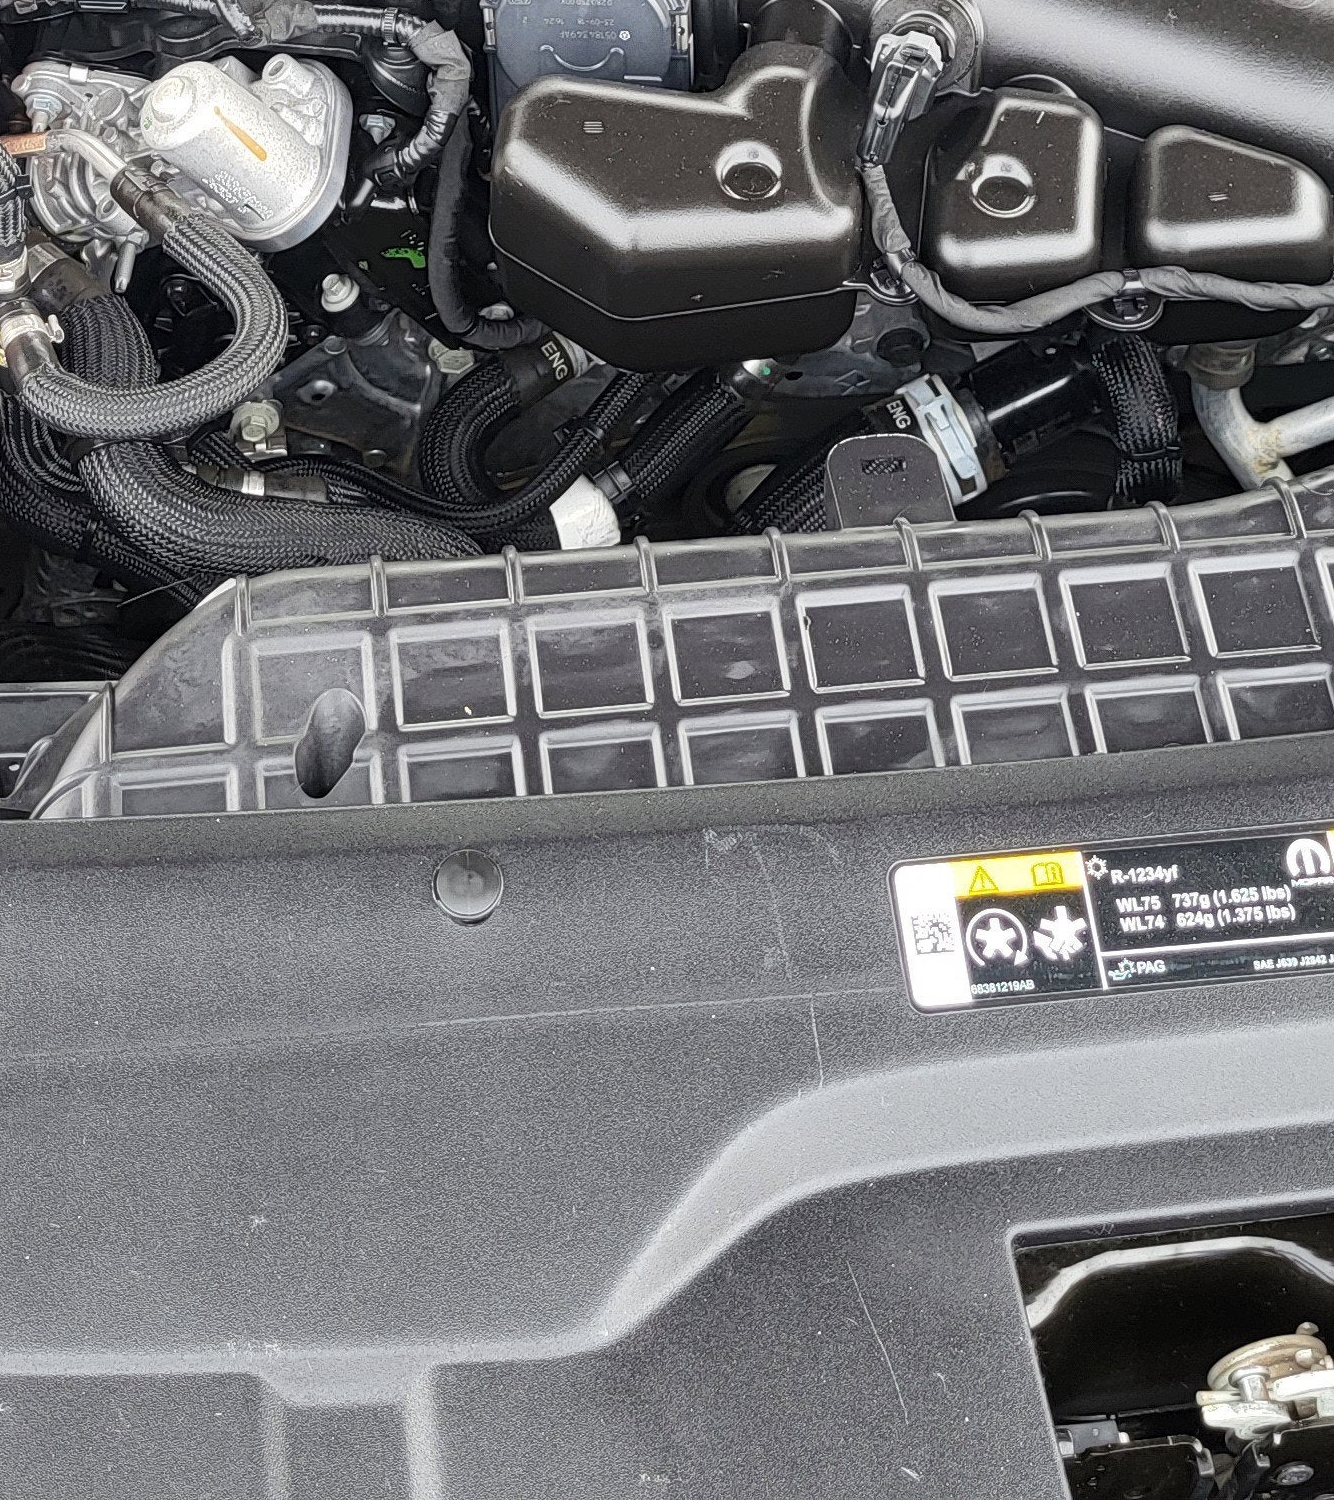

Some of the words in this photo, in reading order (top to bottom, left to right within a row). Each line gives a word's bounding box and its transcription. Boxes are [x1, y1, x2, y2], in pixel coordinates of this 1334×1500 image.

[540, 340, 569, 381] ENG
[885, 399, 912, 430] ENG
[1110, 864, 1179, 885] R-1234yf
[1116, 895, 1161, 914] WL75
[1172, 891, 1211, 910] 737g
[1213, 886, 1260, 907] (1.625
[1261, 884, 1292, 902] lbs)
[1120, 914, 1165, 932] WL74
[1176, 911, 1215, 929] 624g
[1218, 906, 1264, 927] (1.375
[1265, 903, 1296, 922] lbs)
[1136, 960, 1166, 975] PAG
[1253, 959, 1275, 971] SAE
